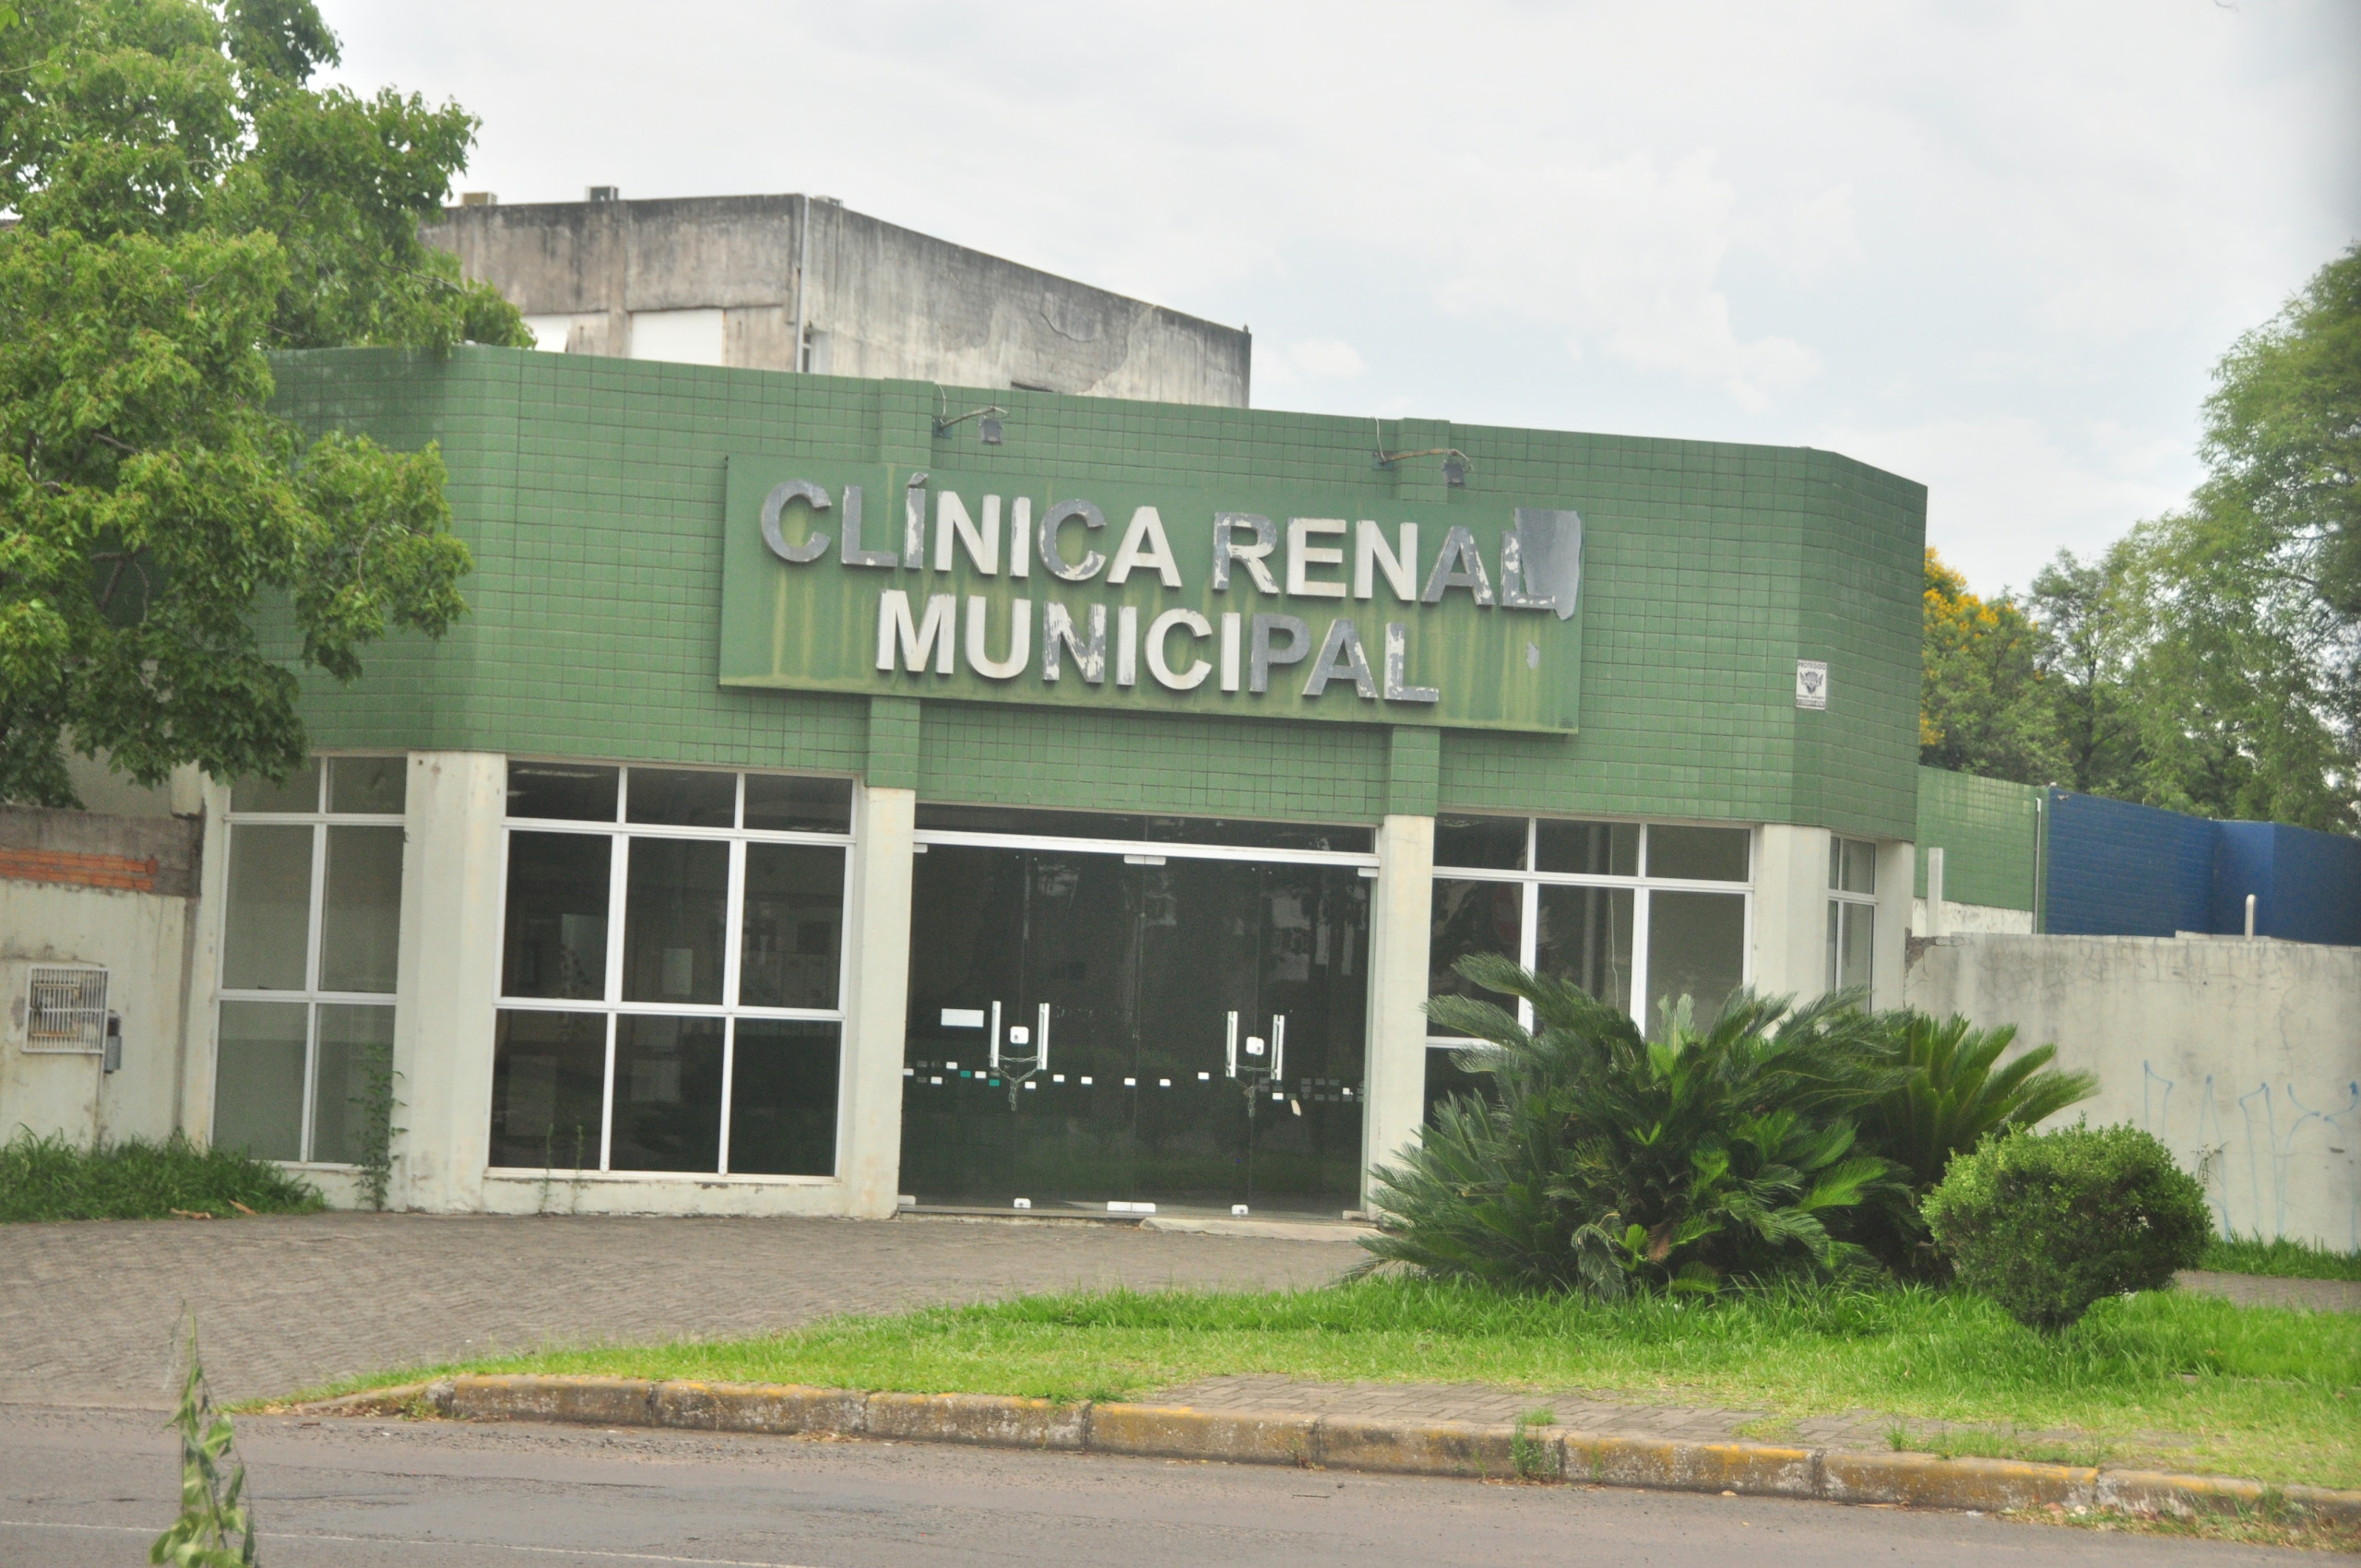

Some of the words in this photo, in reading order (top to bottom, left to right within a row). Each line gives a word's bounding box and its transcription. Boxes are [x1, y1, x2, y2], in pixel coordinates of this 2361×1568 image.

[761, 472, 1182, 588] CLÍNICA
[1212, 512, 1556, 610] RENAL
[875, 588, 1441, 704] MUNICIPAL
[1797, 661, 1826, 670] PROTEGIDO
